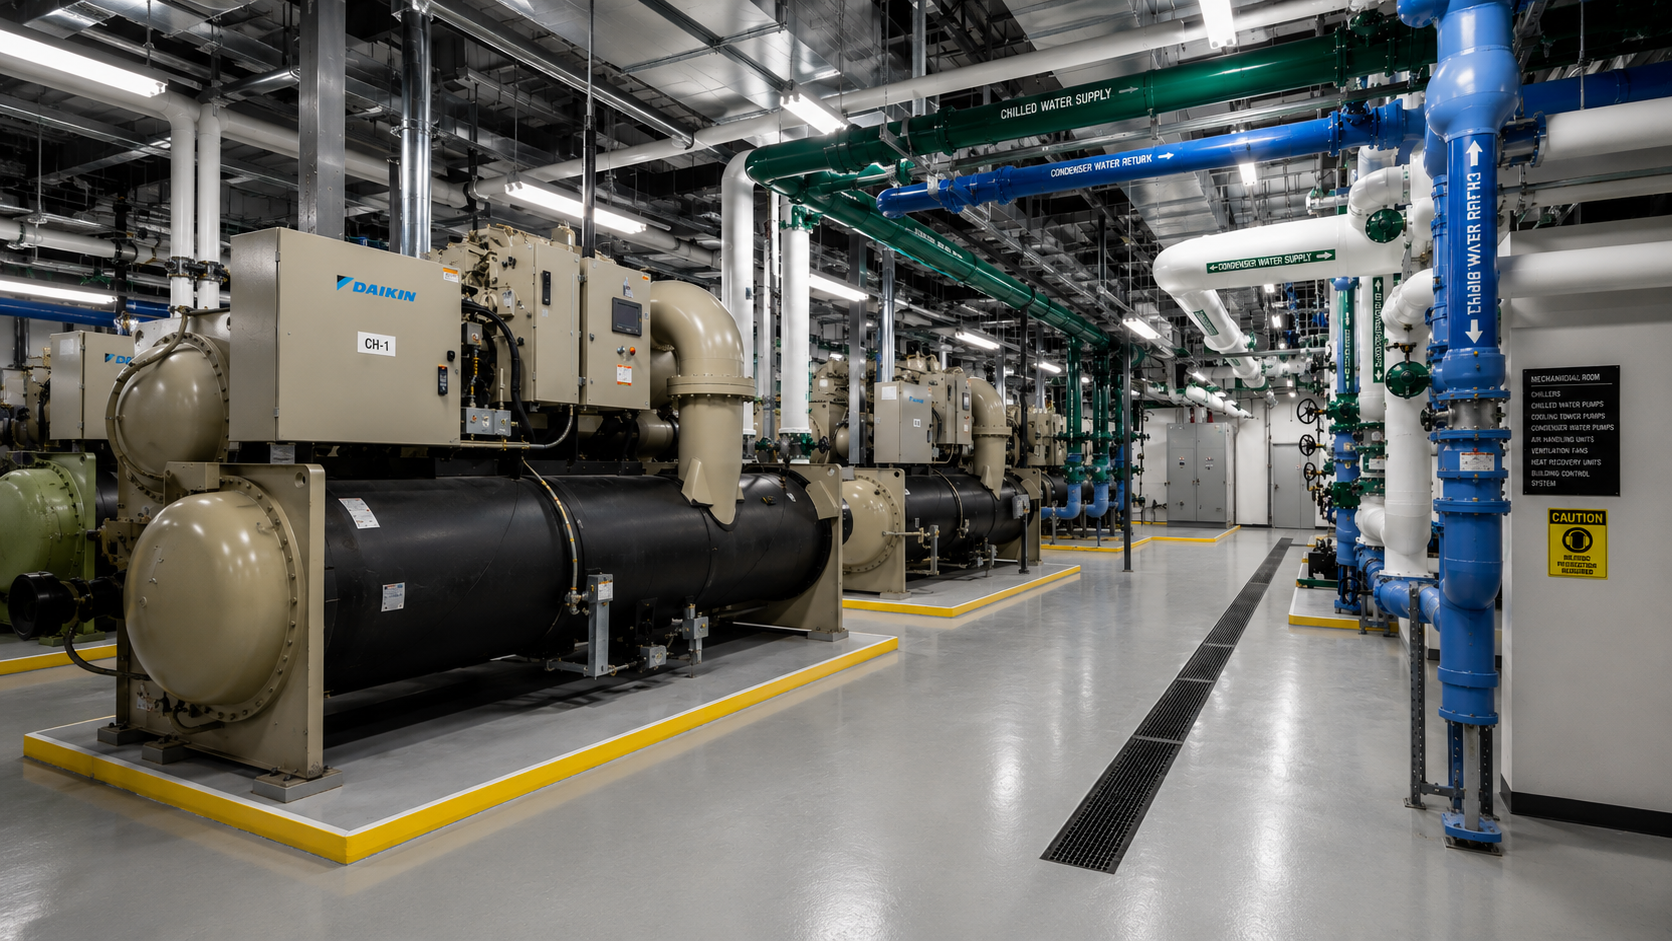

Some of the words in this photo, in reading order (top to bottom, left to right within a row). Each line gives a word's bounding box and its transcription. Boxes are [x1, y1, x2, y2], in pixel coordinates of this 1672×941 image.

[1000, 102, 1038, 120] CHILLED
[1041, 95, 1073, 112] WATER
[1075, 87, 1112, 106] SUPPLY
[1094, 158, 1120, 171] WATER
[1258, 256, 1282, 267] WATER
[1284, 252, 1312, 264] SUPPLY
[353, 281, 417, 302] DAIKIN
[364, 337, 389, 351] CH-1
[1552, 512, 1603, 524] CAUTION
